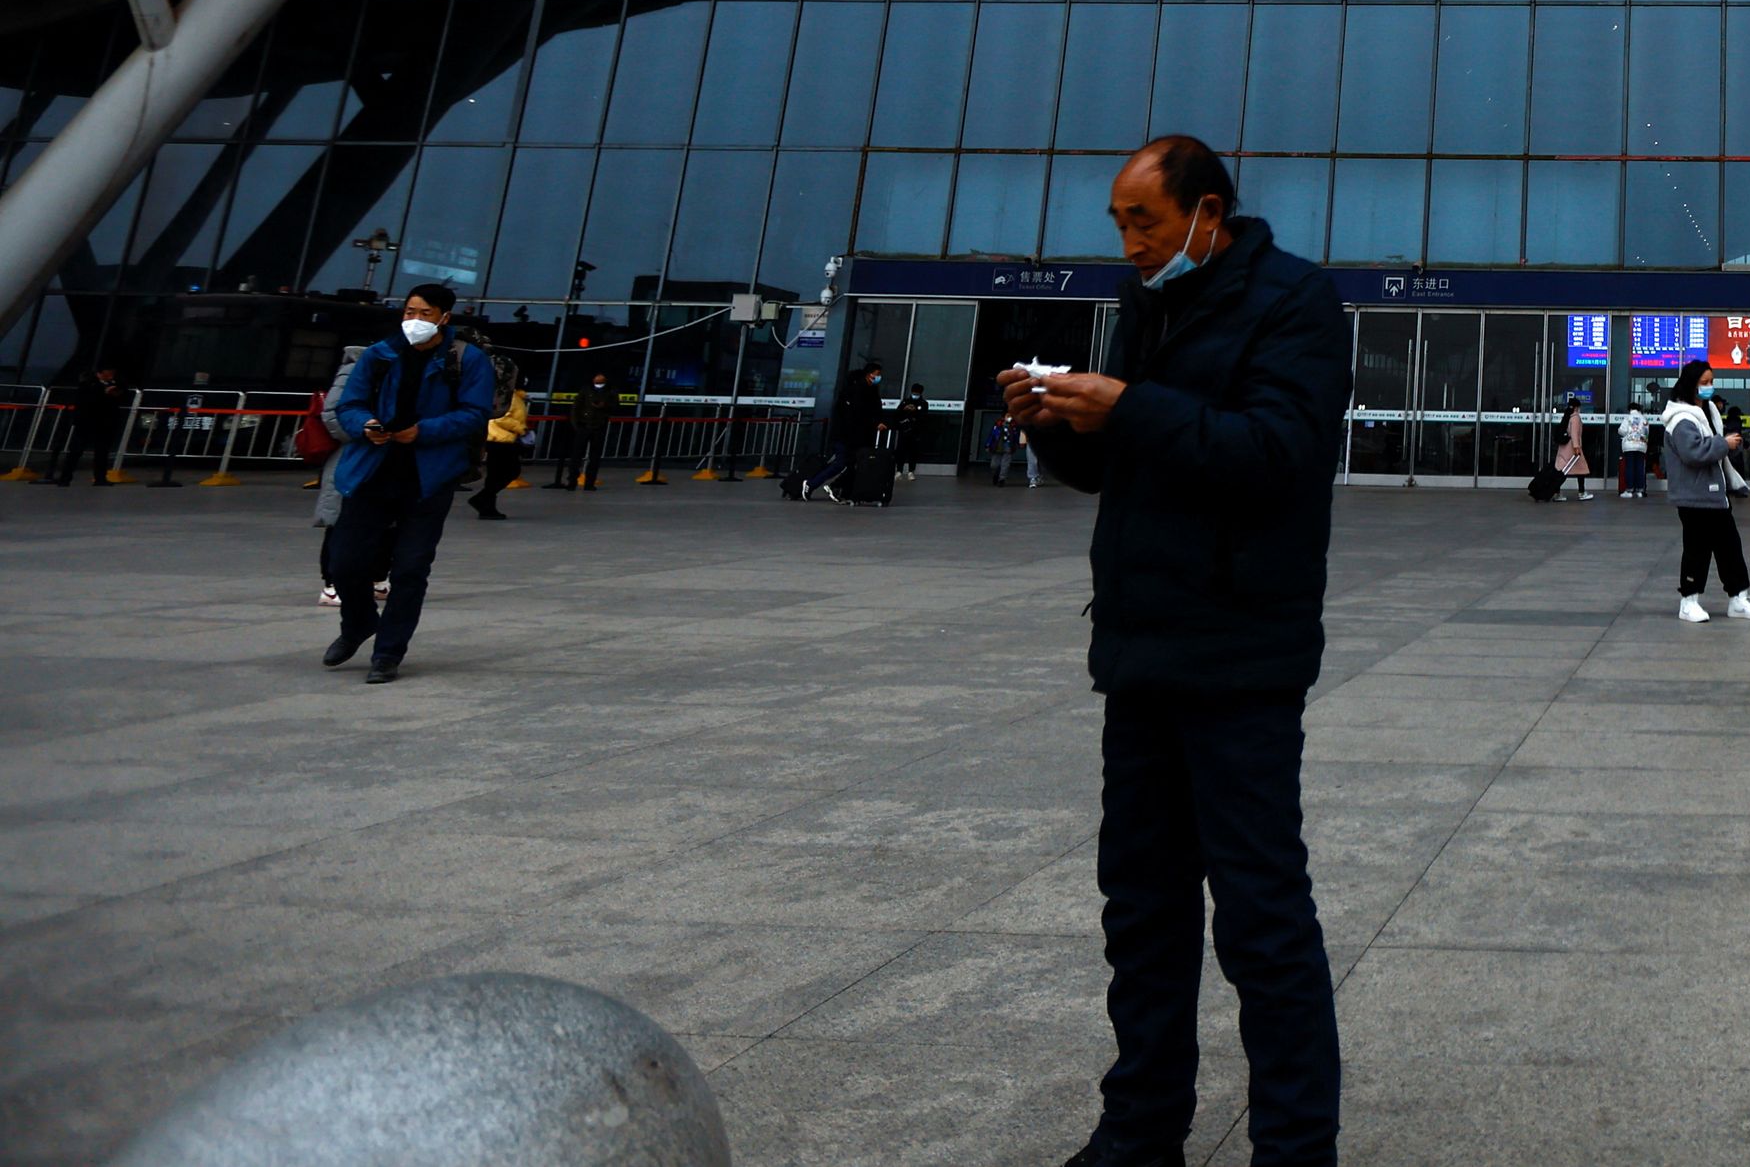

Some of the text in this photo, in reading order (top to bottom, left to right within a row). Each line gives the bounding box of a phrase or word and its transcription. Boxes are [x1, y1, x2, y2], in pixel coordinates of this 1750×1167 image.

[1020, 270, 1074, 291] 售票处 7
[1412, 278, 1449, 290] 东进口
